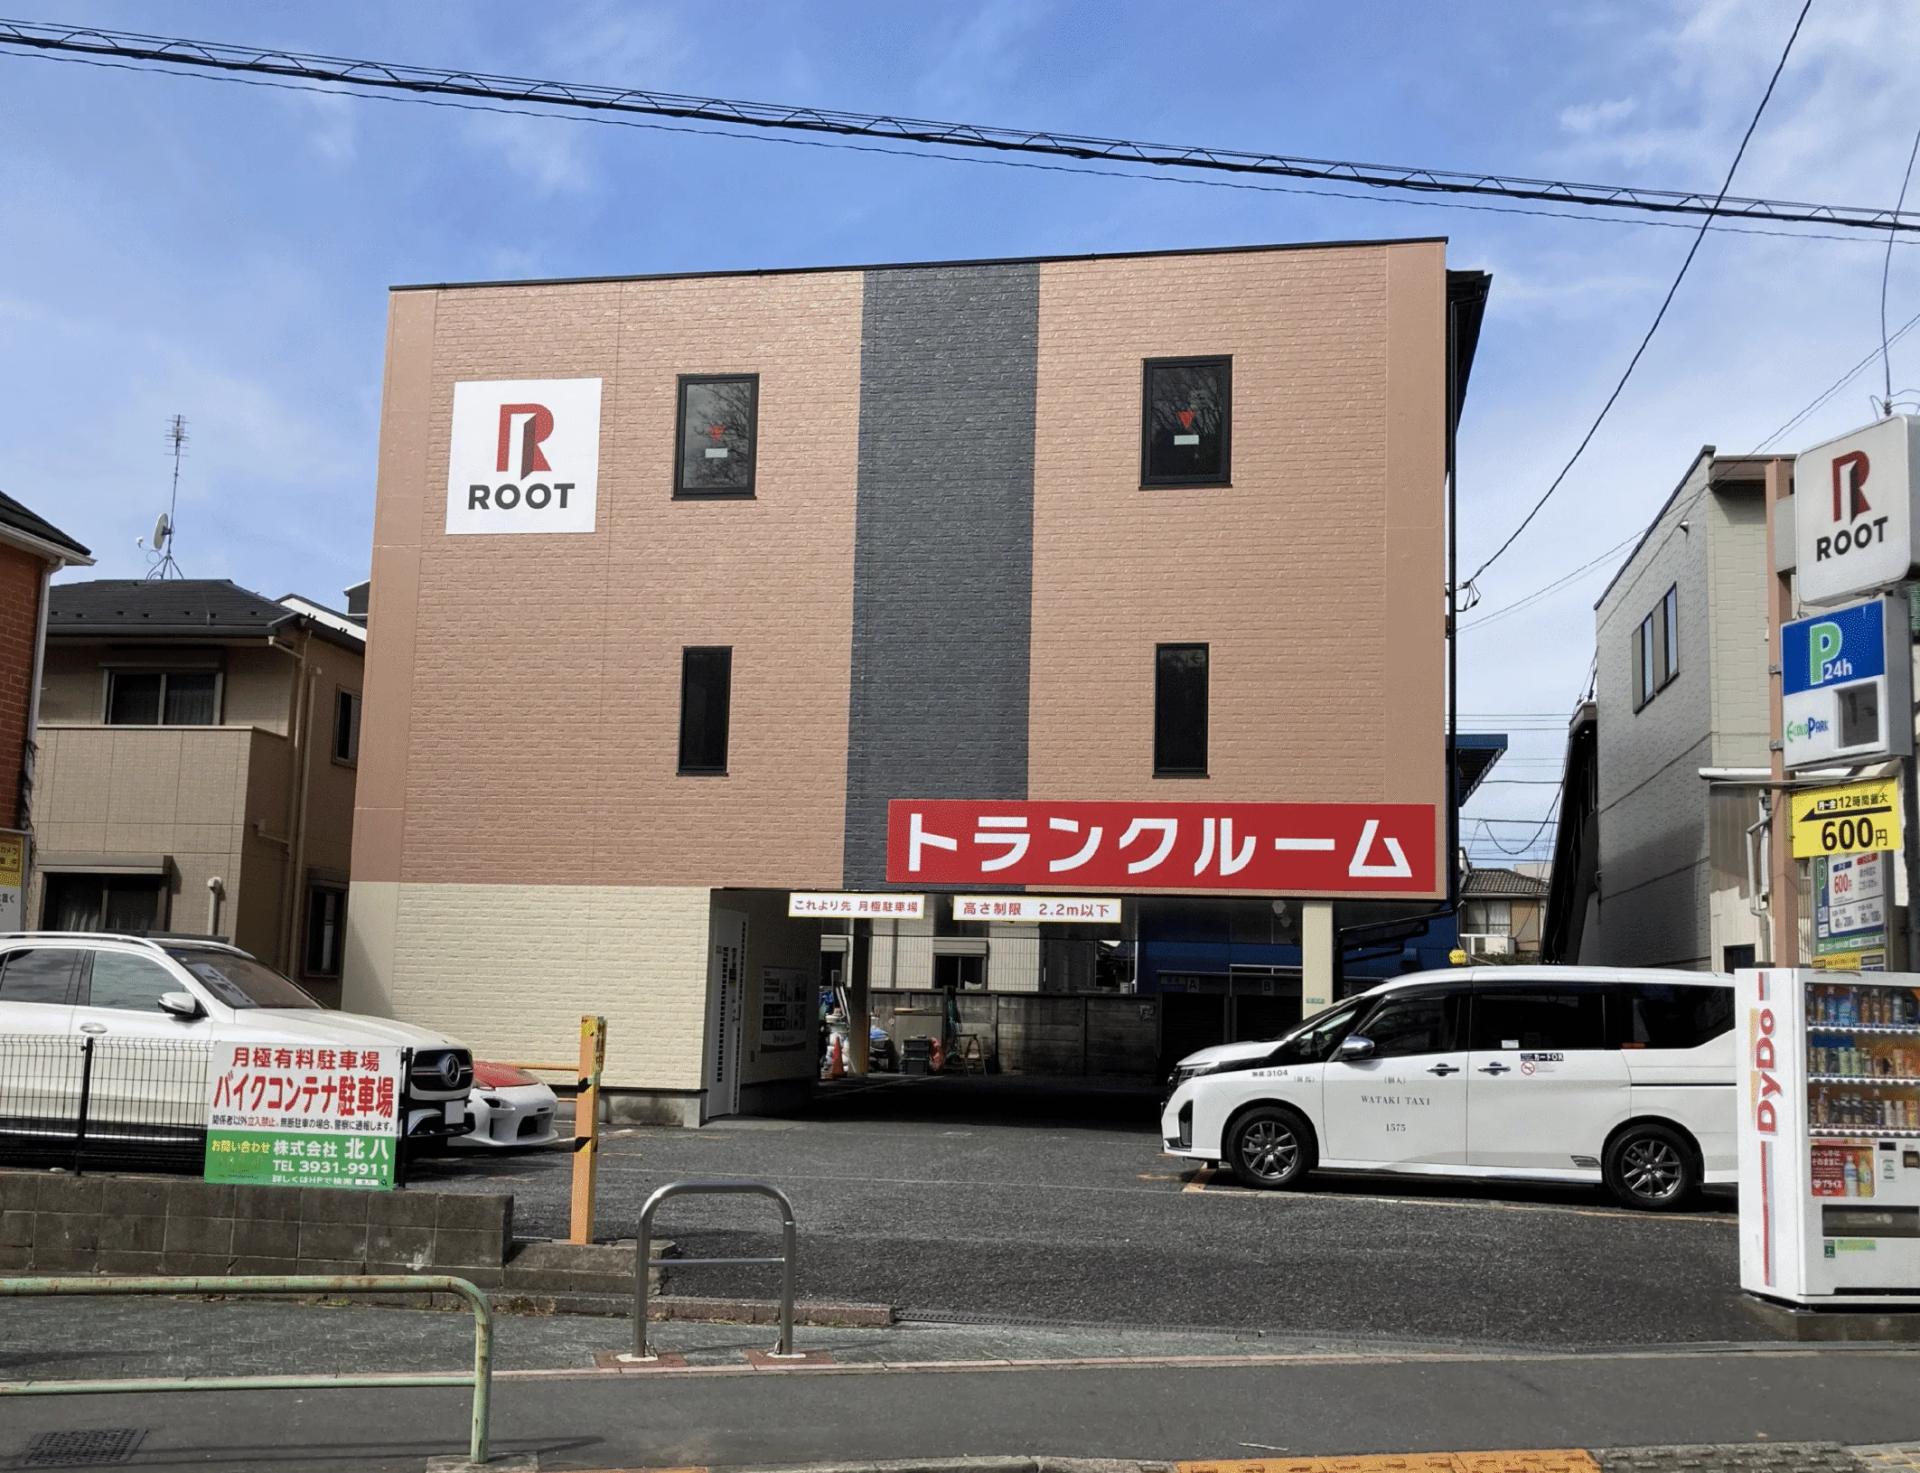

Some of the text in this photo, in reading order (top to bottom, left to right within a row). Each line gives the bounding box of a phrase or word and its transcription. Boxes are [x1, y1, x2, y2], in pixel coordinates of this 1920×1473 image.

[468, 483, 575, 510] ROOT
[1816, 516, 1888, 562] ROOT
[1809, 621, 1843, 686] P
[1824, 659, 1853, 680] 24h
[908, 813, 1413, 878] トランクルーム
[1821, 817, 1888, 851] 600円
[794, 900, 918, 912] これより先 月極駐車場
[963, 902, 1109, 917] 高さ制限 2.2m以下
[232, 1047, 380, 1072] 月極有料駐車場
[214, 1070, 394, 1118] バイクコンテナ駐車場
[1361, 1095, 1430, 1106] WATAKI TAXI
[1386, 1123, 1406, 1132] 1575
[211, 1139, 271, 1154] お問い合わせ
[273, 1139, 337, 1158] 株式会社
[273, 1160, 388, 1176] TEL 3931-9911
